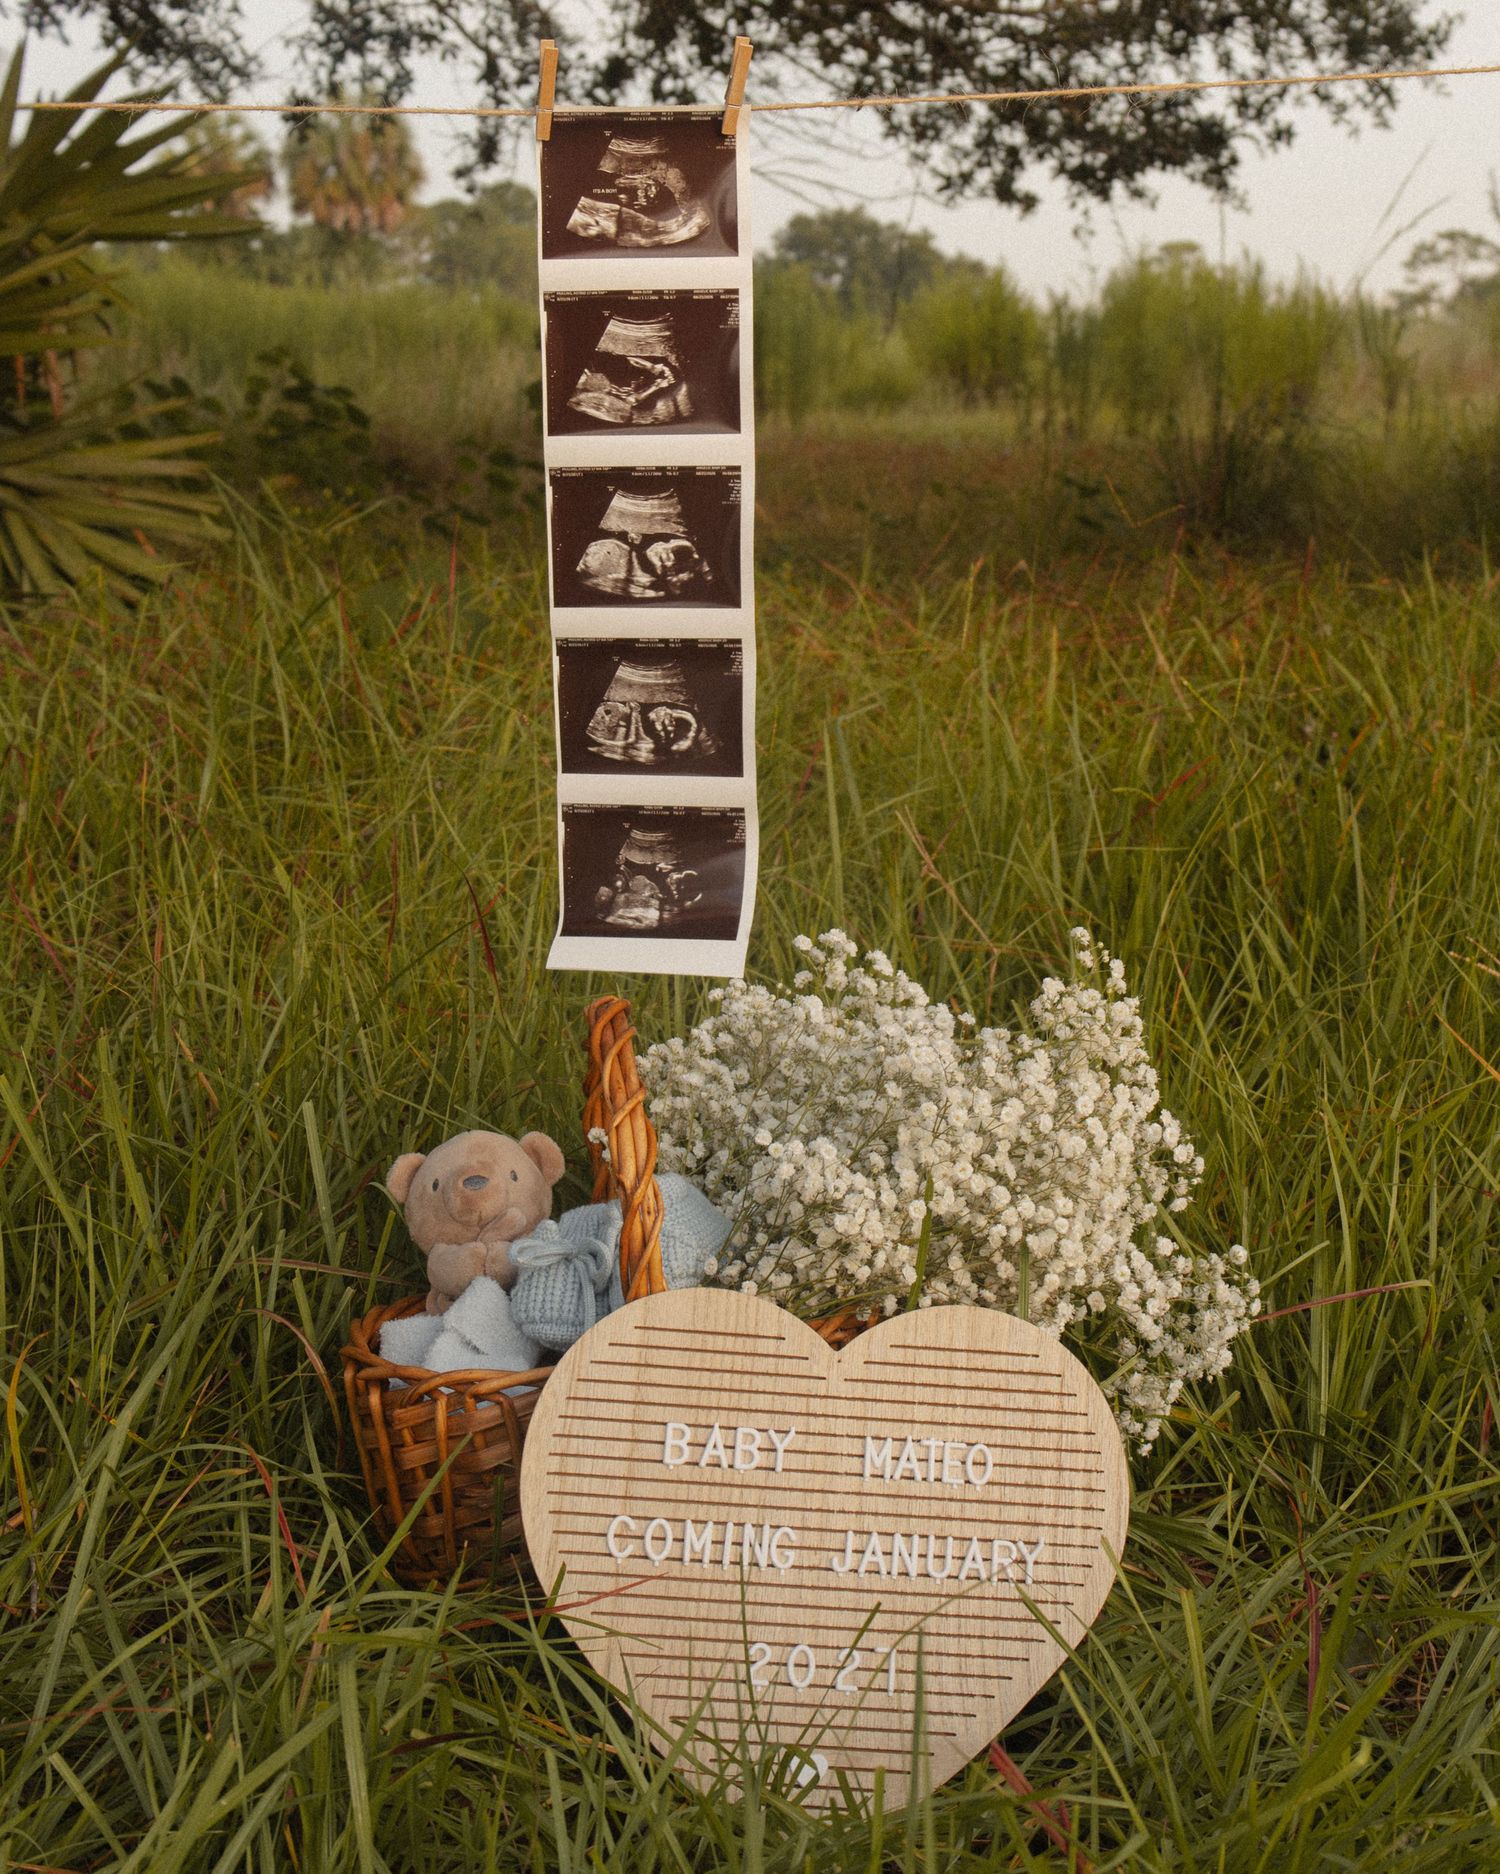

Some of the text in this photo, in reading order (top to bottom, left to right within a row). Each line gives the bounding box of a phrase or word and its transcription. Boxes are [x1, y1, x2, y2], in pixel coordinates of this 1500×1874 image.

[663, 1422, 993, 1489] BABY MATEO
[606, 1515, 1046, 1586] COMING JANUARY
